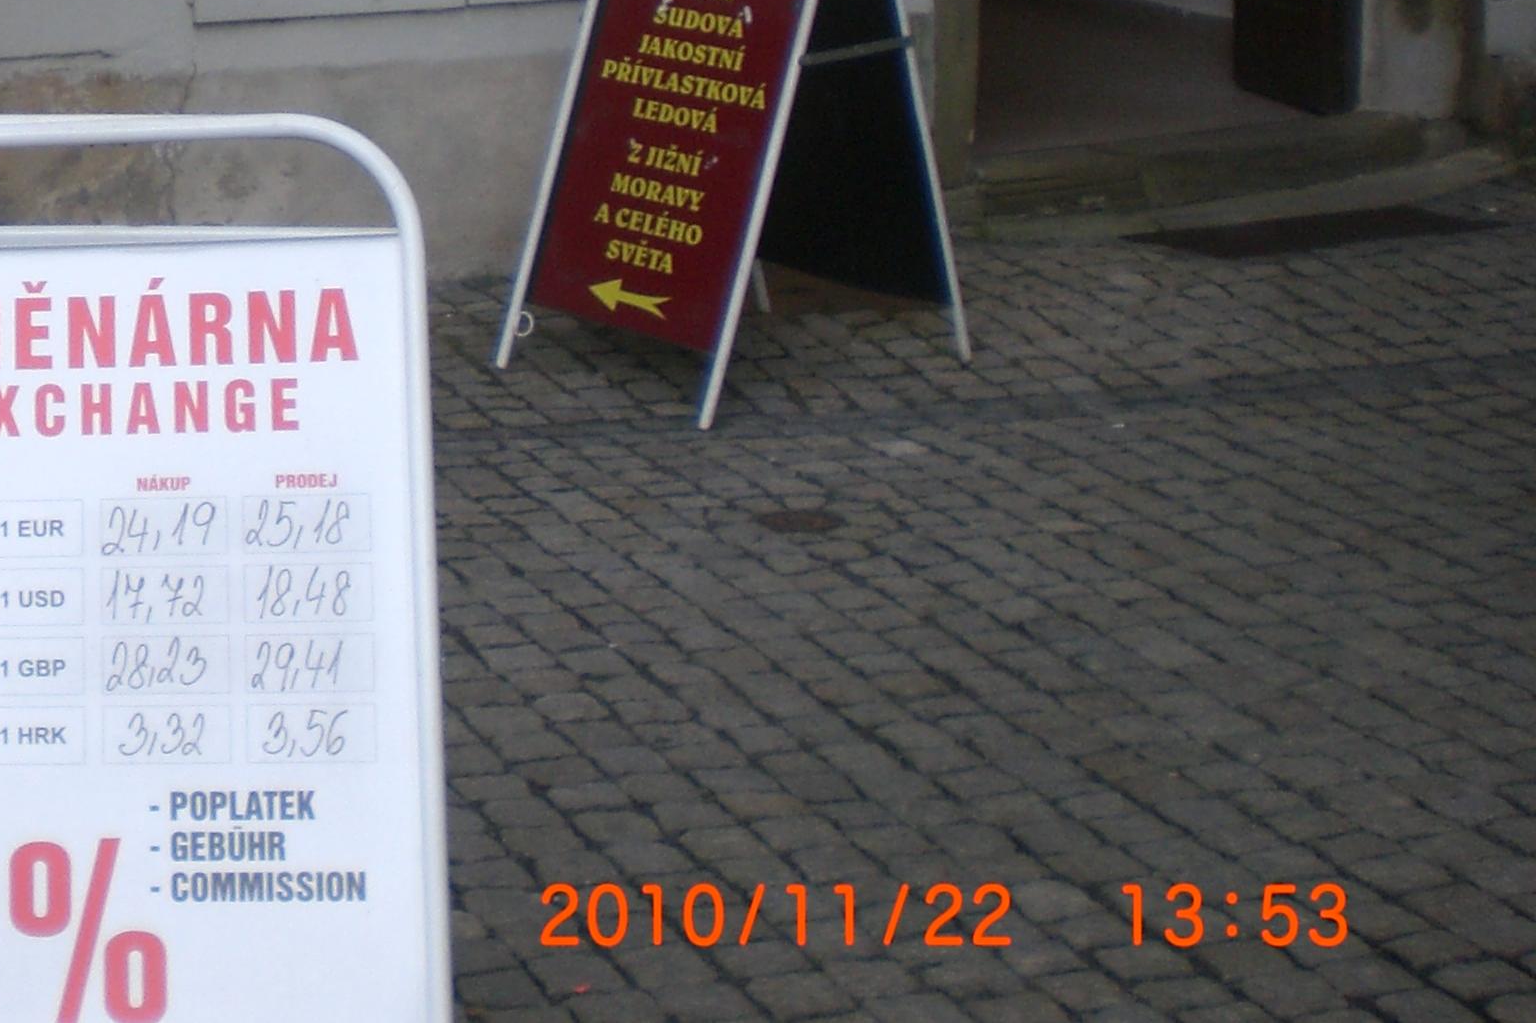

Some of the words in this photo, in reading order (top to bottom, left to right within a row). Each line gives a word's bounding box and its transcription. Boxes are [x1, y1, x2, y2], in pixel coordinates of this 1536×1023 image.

[638, 33, 746, 72] JAKOSTNÍ
[601, 54, 766, 110] PŘÍVLASTKOVÁ
[632, 97, 718, 133] LEDOVÁ
[627, 142, 644, 164] Z
[645, 143, 704, 177] JIŽNÍ
[610, 172, 706, 213] MORAVY
[594, 202, 610, 225] A
[615, 207, 704, 246] CELÉHO
[606, 238, 674, 275] SVĚTA
[136, 475, 192, 492] NÁKUP
[275, 473, 338, 489] PRODEJ
[0, 520, 9, 538] 1
[17, 519, 65, 538] EUR
[245, 499, 350, 550] 25,18
[0, 590, 9, 609] 1
[18, 589, 66, 609] USD
[257, 565, 351, 619] 18,48
[0, 659, 9, 678] 1
[18, 658, 66, 678] GBP
[105, 636, 207, 692] 28,23
[251, 639, 344, 692] 29,41
[0, 727, 9, 745] 1
[17, 726, 67, 745] HRK
[118, 713, 206, 757] 3,32
[263, 709, 349, 758] 3,56
[169, 790, 316, 822] POPLATEK
[170, 825, 286, 862] GEBÜHR
[170, 871, 366, 902] COMMISSION
